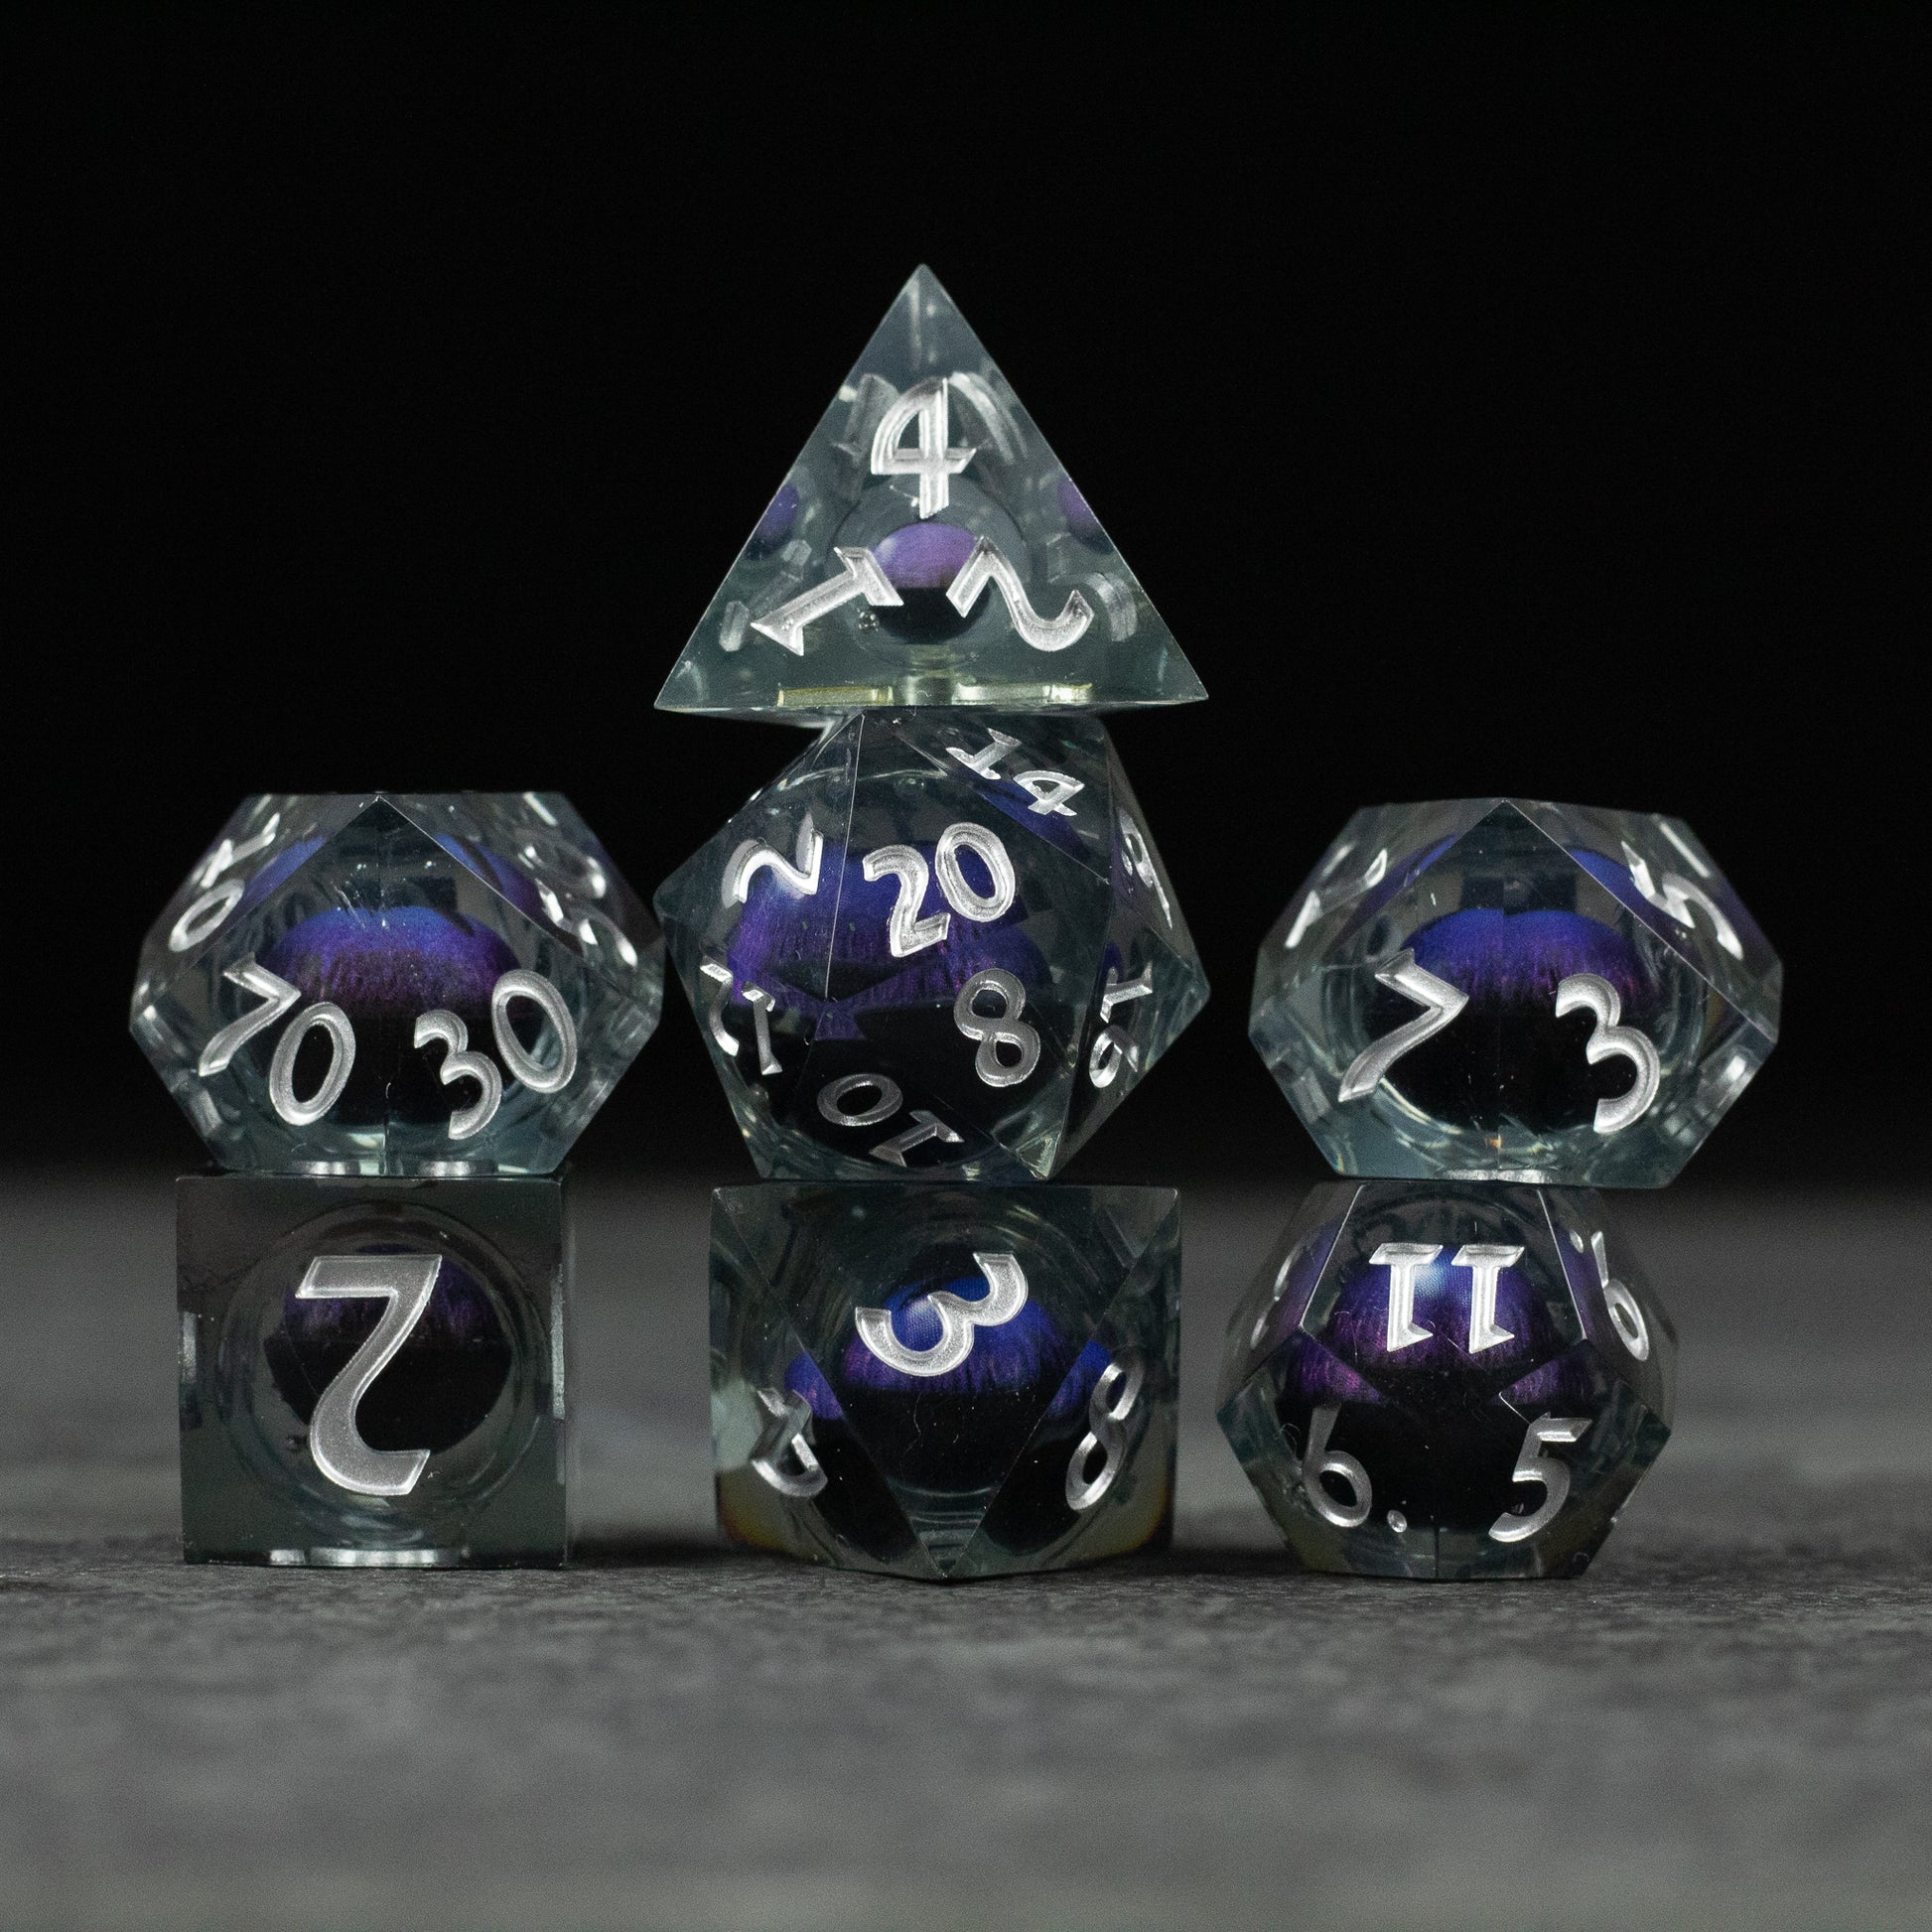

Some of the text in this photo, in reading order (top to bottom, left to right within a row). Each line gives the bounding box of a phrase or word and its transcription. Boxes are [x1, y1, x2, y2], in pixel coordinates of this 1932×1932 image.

[871, 377, 977, 519] 4
[751, 547, 904, 656] 1
[946, 728, 1085, 817] 14
[863, 822, 1016, 957] 20
[198, 952, 356, 1127] 70
[414, 968, 578, 1141] 30
[954, 968, 1040, 1088] 8
[1337, 948, 1470, 1103] 7
[1556, 973, 1661, 1134] 3
[817, 1073, 965, 1169] 10
[855, 1250, 1029, 1378] 3
[1369, 1242, 1525, 1354] 11
[1064, 1357, 1145, 1512] 8
[1488, 1412, 1593, 1544] 5
